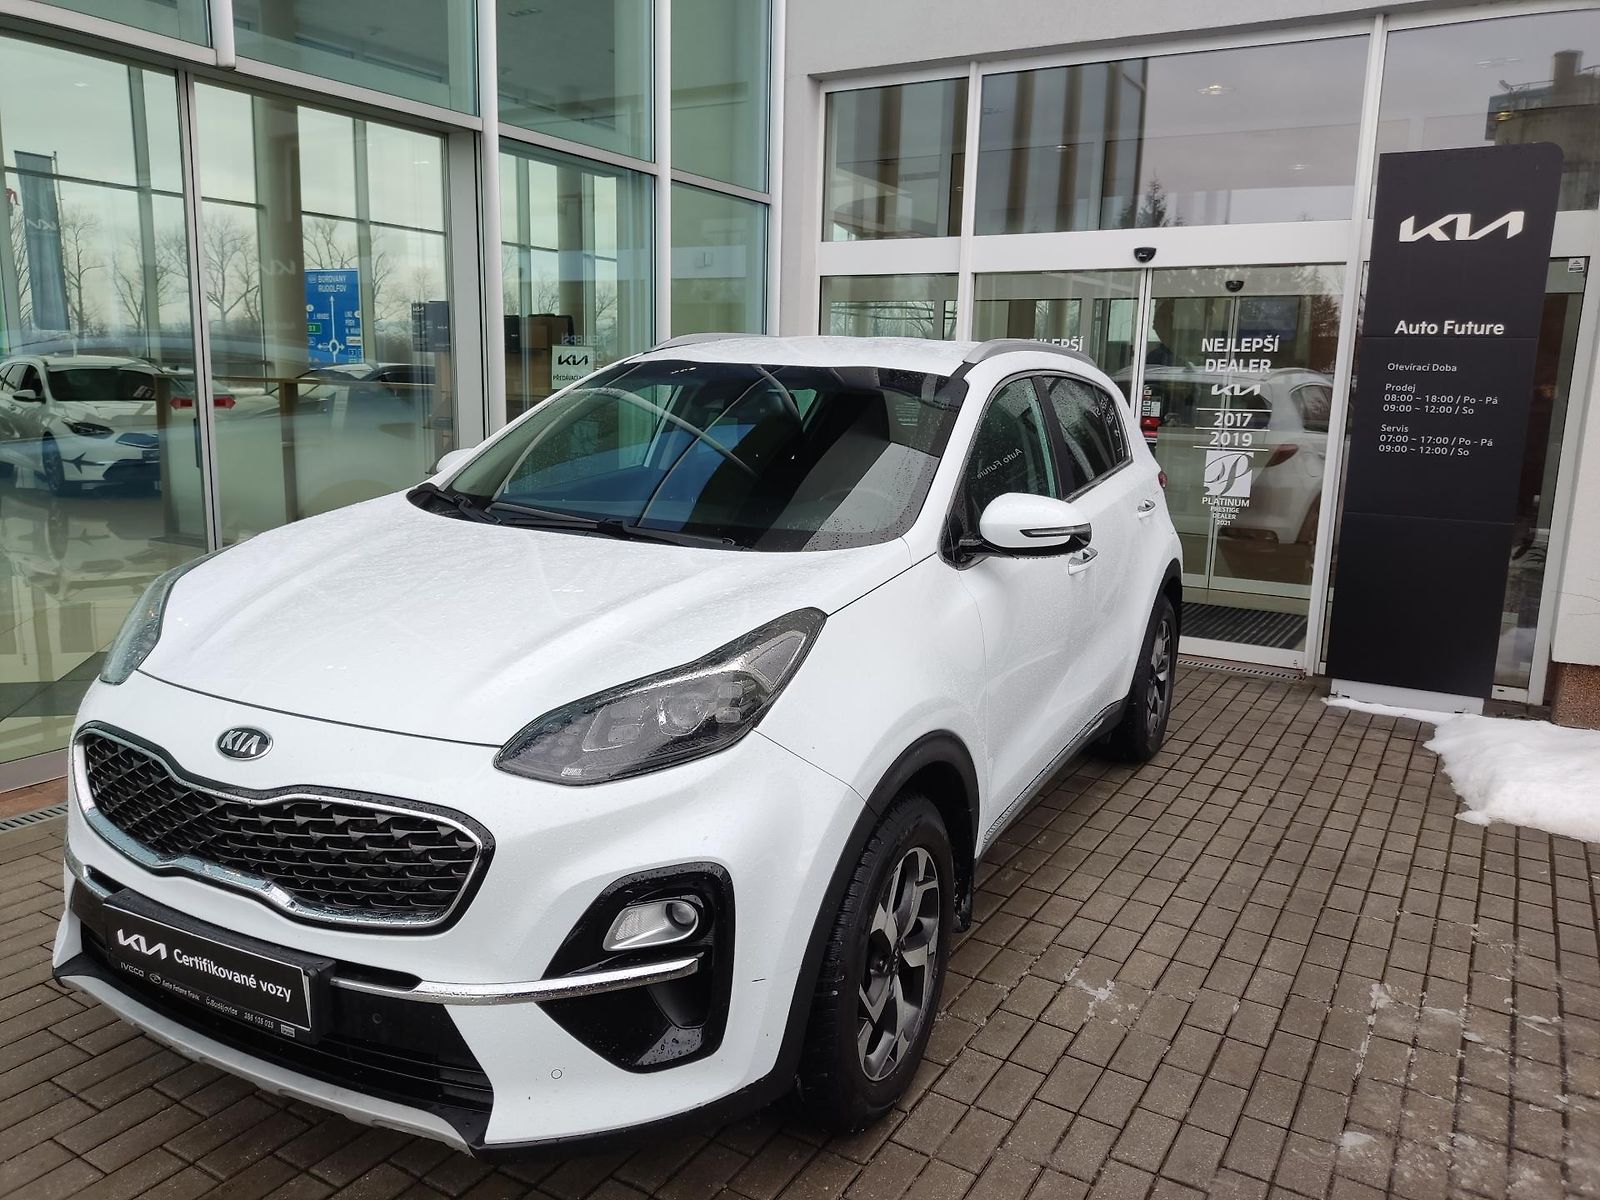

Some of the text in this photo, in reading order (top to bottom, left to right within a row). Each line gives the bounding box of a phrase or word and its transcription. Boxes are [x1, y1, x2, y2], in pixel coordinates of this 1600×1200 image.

[1399, 211, 1525, 242] KIA
[1394, 320, 1505, 335] Auto Future
[1201, 334, 1280, 353] NEJLEPŠÍ
[558, 355, 588, 366] KIA
[1205, 358, 1271, 373] DEALER
[1432, 363, 1457, 372] Doba
[1211, 383, 1261, 396] KIA
[1385, 383, 1416, 394] Prodej
[1384, 394, 1413, 403] 08:00
[1425, 394, 1454, 404] 18:00
[1463, 395, 1476, 404] Po
[1485, 396, 1498, 405] Pá
[1383, 404, 1412, 413] 09:00
[1424, 405, 1453, 414] 12:00
[1462, 406, 1474, 415] So
[1213, 412, 1253, 427] 2017
[1381, 423, 1409, 433] Servis
[1209, 431, 1253, 447] 2019
[1379, 434, 1409, 443] 07:00
[1420, 435, 1449, 445] 17:00
[1458, 437, 1471, 446] Po
[1480, 438, 1493, 447] Pá
[1378, 444, 1408, 454] 09:00
[1419, 446, 1448, 455] 12:00
[1457, 448, 1470, 456] So
[1201, 497, 1250, 508] PLATINUM
[1210, 505, 1240, 514] PRESTIGE
[220, 730, 261, 755] KIA
[117, 928, 292, 1003] KIA Certifikované vozy
